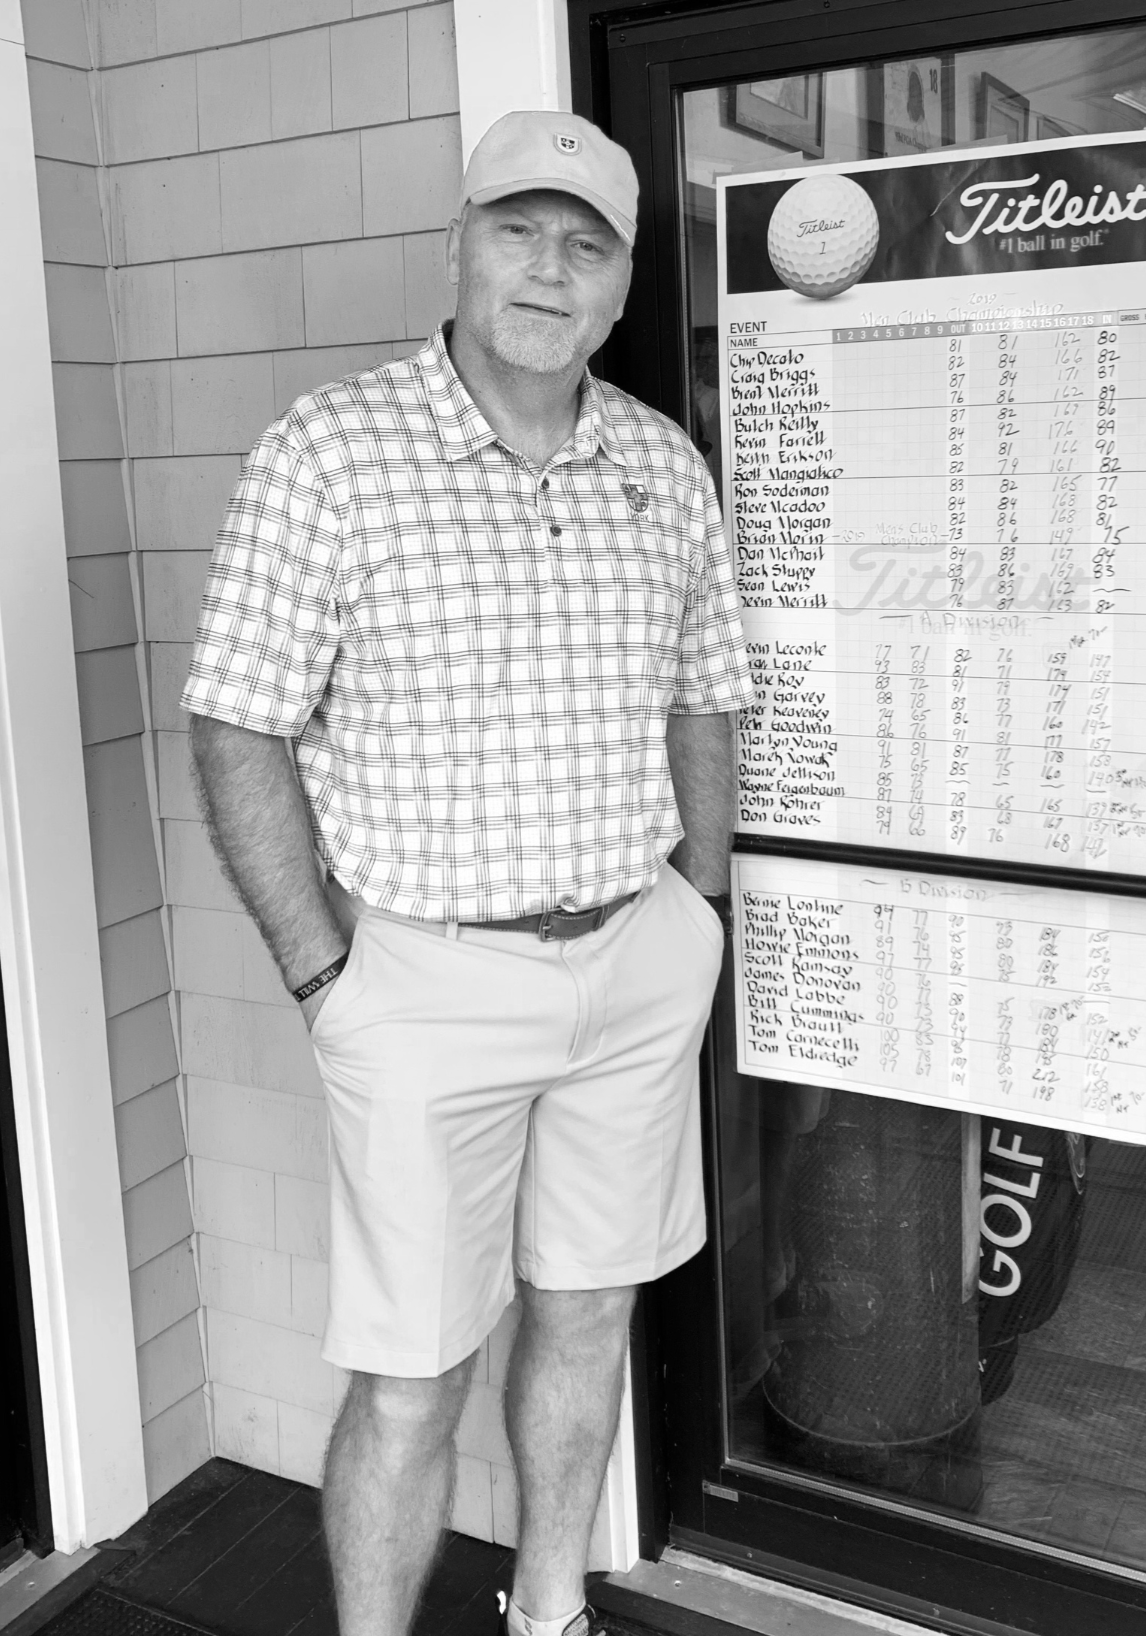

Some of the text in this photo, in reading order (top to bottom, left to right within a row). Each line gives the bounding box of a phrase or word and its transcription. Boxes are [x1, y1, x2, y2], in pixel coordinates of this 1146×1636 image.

[945, 173, 1146, 245] Titleist
[796, 219, 846, 238] Titleist
[818, 241, 827, 255] 1
[999, 238, 1013, 253] #1
[1017, 234, 1045, 253] ball
[1050, 234, 1066, 250] in
[897, 308, 937, 325] Club
[730, 321, 767, 334] EVENT
[730, 314, 1140, 348] NAME 1 2 3 4 5 6 7 8 9 OUT 10 11 12 13 14 15 16 17 18 IN GROSS
[730, 353, 755, 368] Chip
[949, 338, 961, 352] 81
[998, 334, 1018, 350] 81
[1097, 330, 1117, 345] 80
[731, 370, 765, 385] Craig
[770, 367, 815, 386] Briggs
[948, 355, 965, 370] 82
[998, 354, 1017, 369] 84
[1097, 349, 1121, 364] 82
[731, 364, 1115, 400] Brent Merritt 87 84 87
[732, 402, 766, 416] John
[771, 400, 831, 417] Hopkins
[950, 390, 964, 404] 76
[997, 389, 1014, 404] 86
[734, 401, 1116, 433] Butch Reilly 87 82 86
[734, 423, 1020, 449] Kevin Farrell 84 92
[736, 449, 836, 465] Keith Erikson
[734, 467, 762, 481] Scott
[1099, 457, 1121, 473] 82
[735, 478, 1018, 500] Ron Soderman 83 82
[735, 500, 767, 514] Steve
[736, 515, 832, 532] Doug Morgan
[737, 529, 776, 544] Brian
[780, 530, 828, 544] Morin
[737, 546, 764, 561] Dan
[737, 562, 769, 577] Zack
[737, 579, 811, 592] Sean Lewis
[778, 593, 828, 608] Merritt
[746, 642, 770, 655] evin
[773, 657, 812, 671] Lane
[778, 671, 805, 689] Roy
[773, 687, 826, 707] Garvey
[877, 692, 893, 704] 88
[770, 718, 833, 735] Goodwin
[791, 735, 838, 756] Young
[739, 748, 830, 768] Marek Nowak
[738, 763, 777, 777] Duane
[738, 778, 774, 794] Wayne
[739, 794, 774, 808] John
[740, 809, 821, 826] Don Graves
[743, 892, 781, 909] Bernie
[745, 908, 837, 930] Brad Baker
[745, 922, 851, 948] Phillip Morgan
[745, 938, 859, 960] Howie Emmons
[744, 951, 853, 979] Scott Ramsay
[318, 968, 338, 984] THE
[744, 967, 861, 992] James Donovan
[298, 981, 320, 998] WILL
[746, 980, 846, 1006] David Labbe
[748, 994, 777, 1011] Bill
[750, 1009, 842, 1034] Rick Brault
[748, 1024, 776, 1039] Tom
[748, 1040, 858, 1069] Tom Eldredge
[978, 1127, 1044, 1297] GOLF
